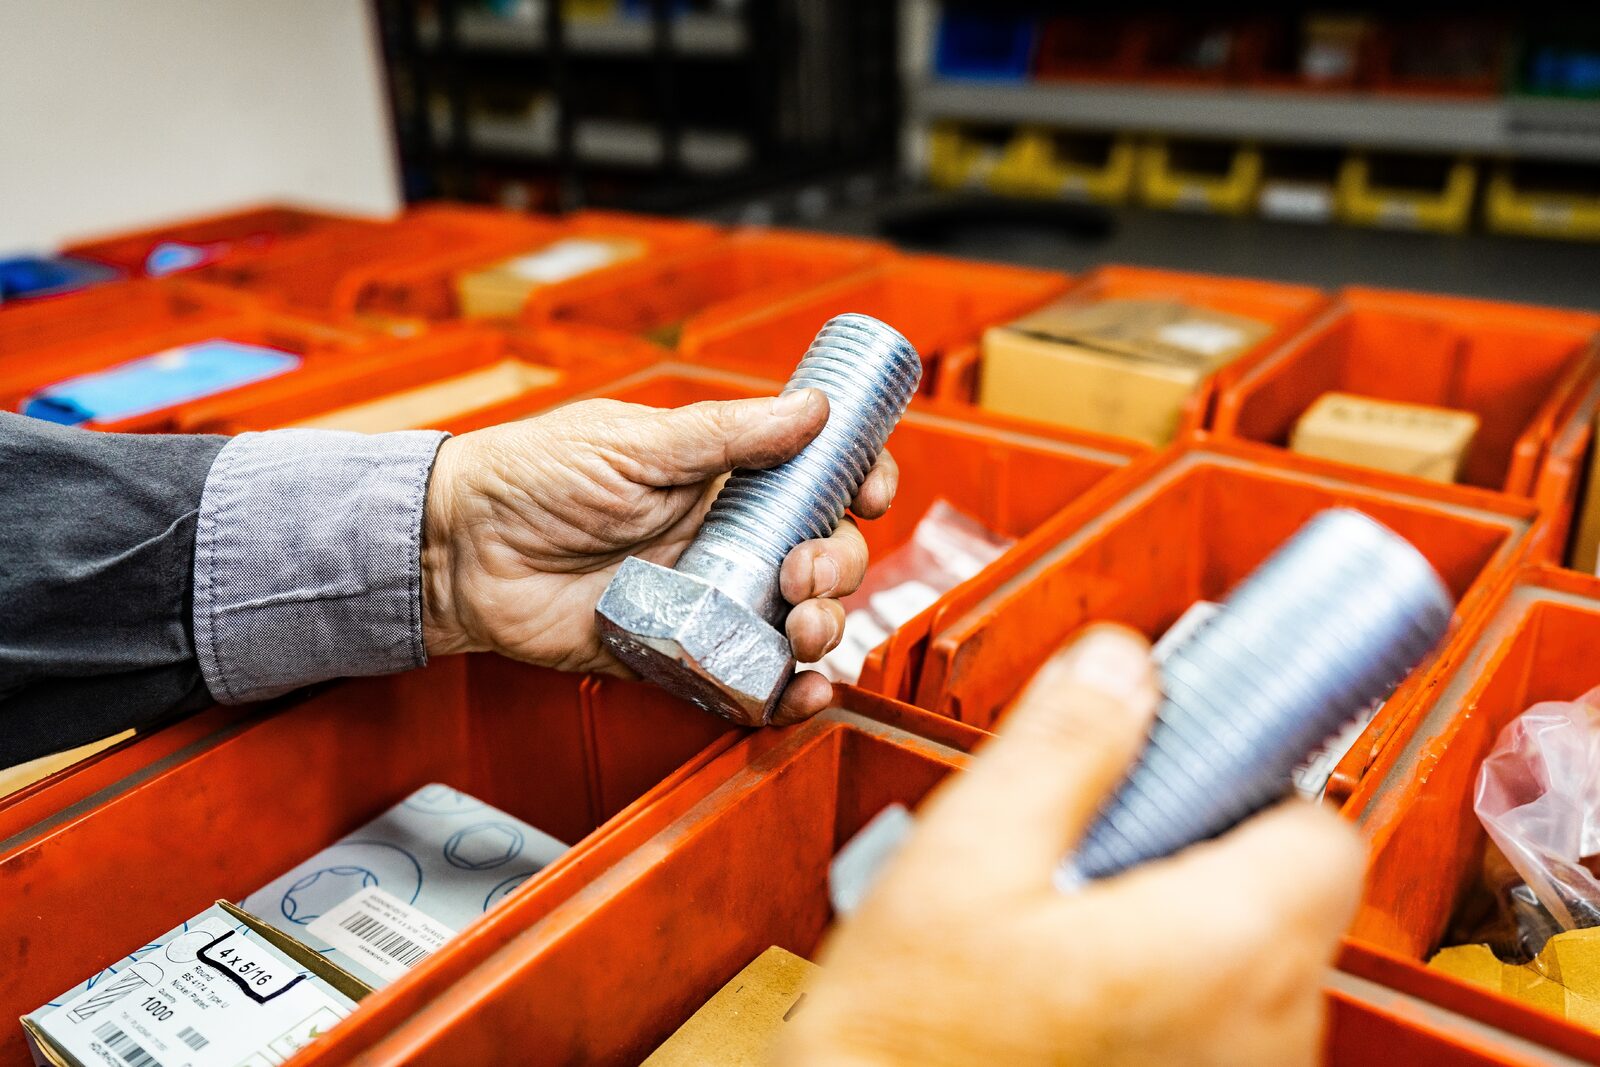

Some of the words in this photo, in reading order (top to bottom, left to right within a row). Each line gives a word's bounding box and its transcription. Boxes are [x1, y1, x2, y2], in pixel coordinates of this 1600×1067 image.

[193, 966, 213, 982] Round
[219, 948, 235, 958] 4
[227, 956, 242, 966] x
[238, 961, 273, 985] 5/16
[171, 979, 194, 999] Nickel
[189, 993, 210, 1010] Plated
[182, 973, 194, 984] BS
[207, 990, 225, 1007] Type
[140, 996, 174, 1021] 1000
